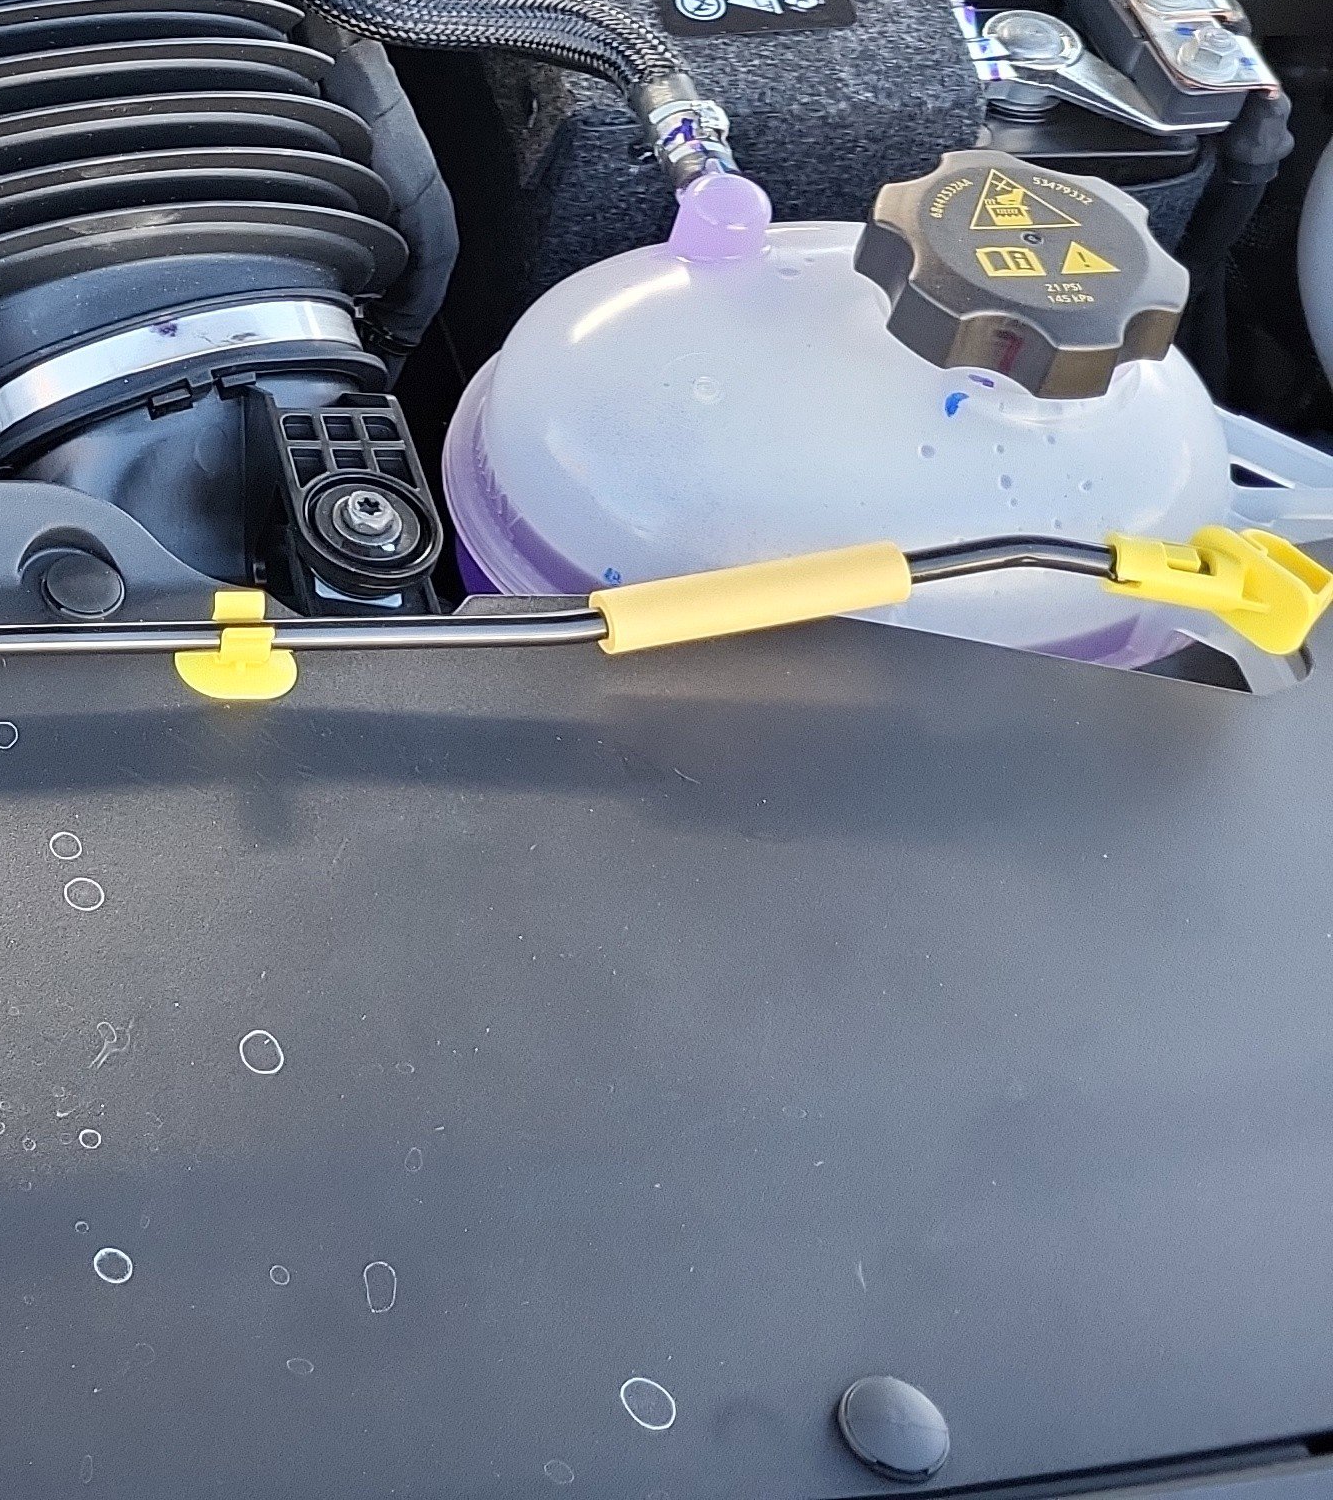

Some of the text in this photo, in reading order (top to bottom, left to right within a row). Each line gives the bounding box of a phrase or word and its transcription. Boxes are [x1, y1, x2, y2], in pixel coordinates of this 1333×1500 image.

[1045, 283, 1082, 292] 21 PSI
[1047, 294, 1072, 303] 145
